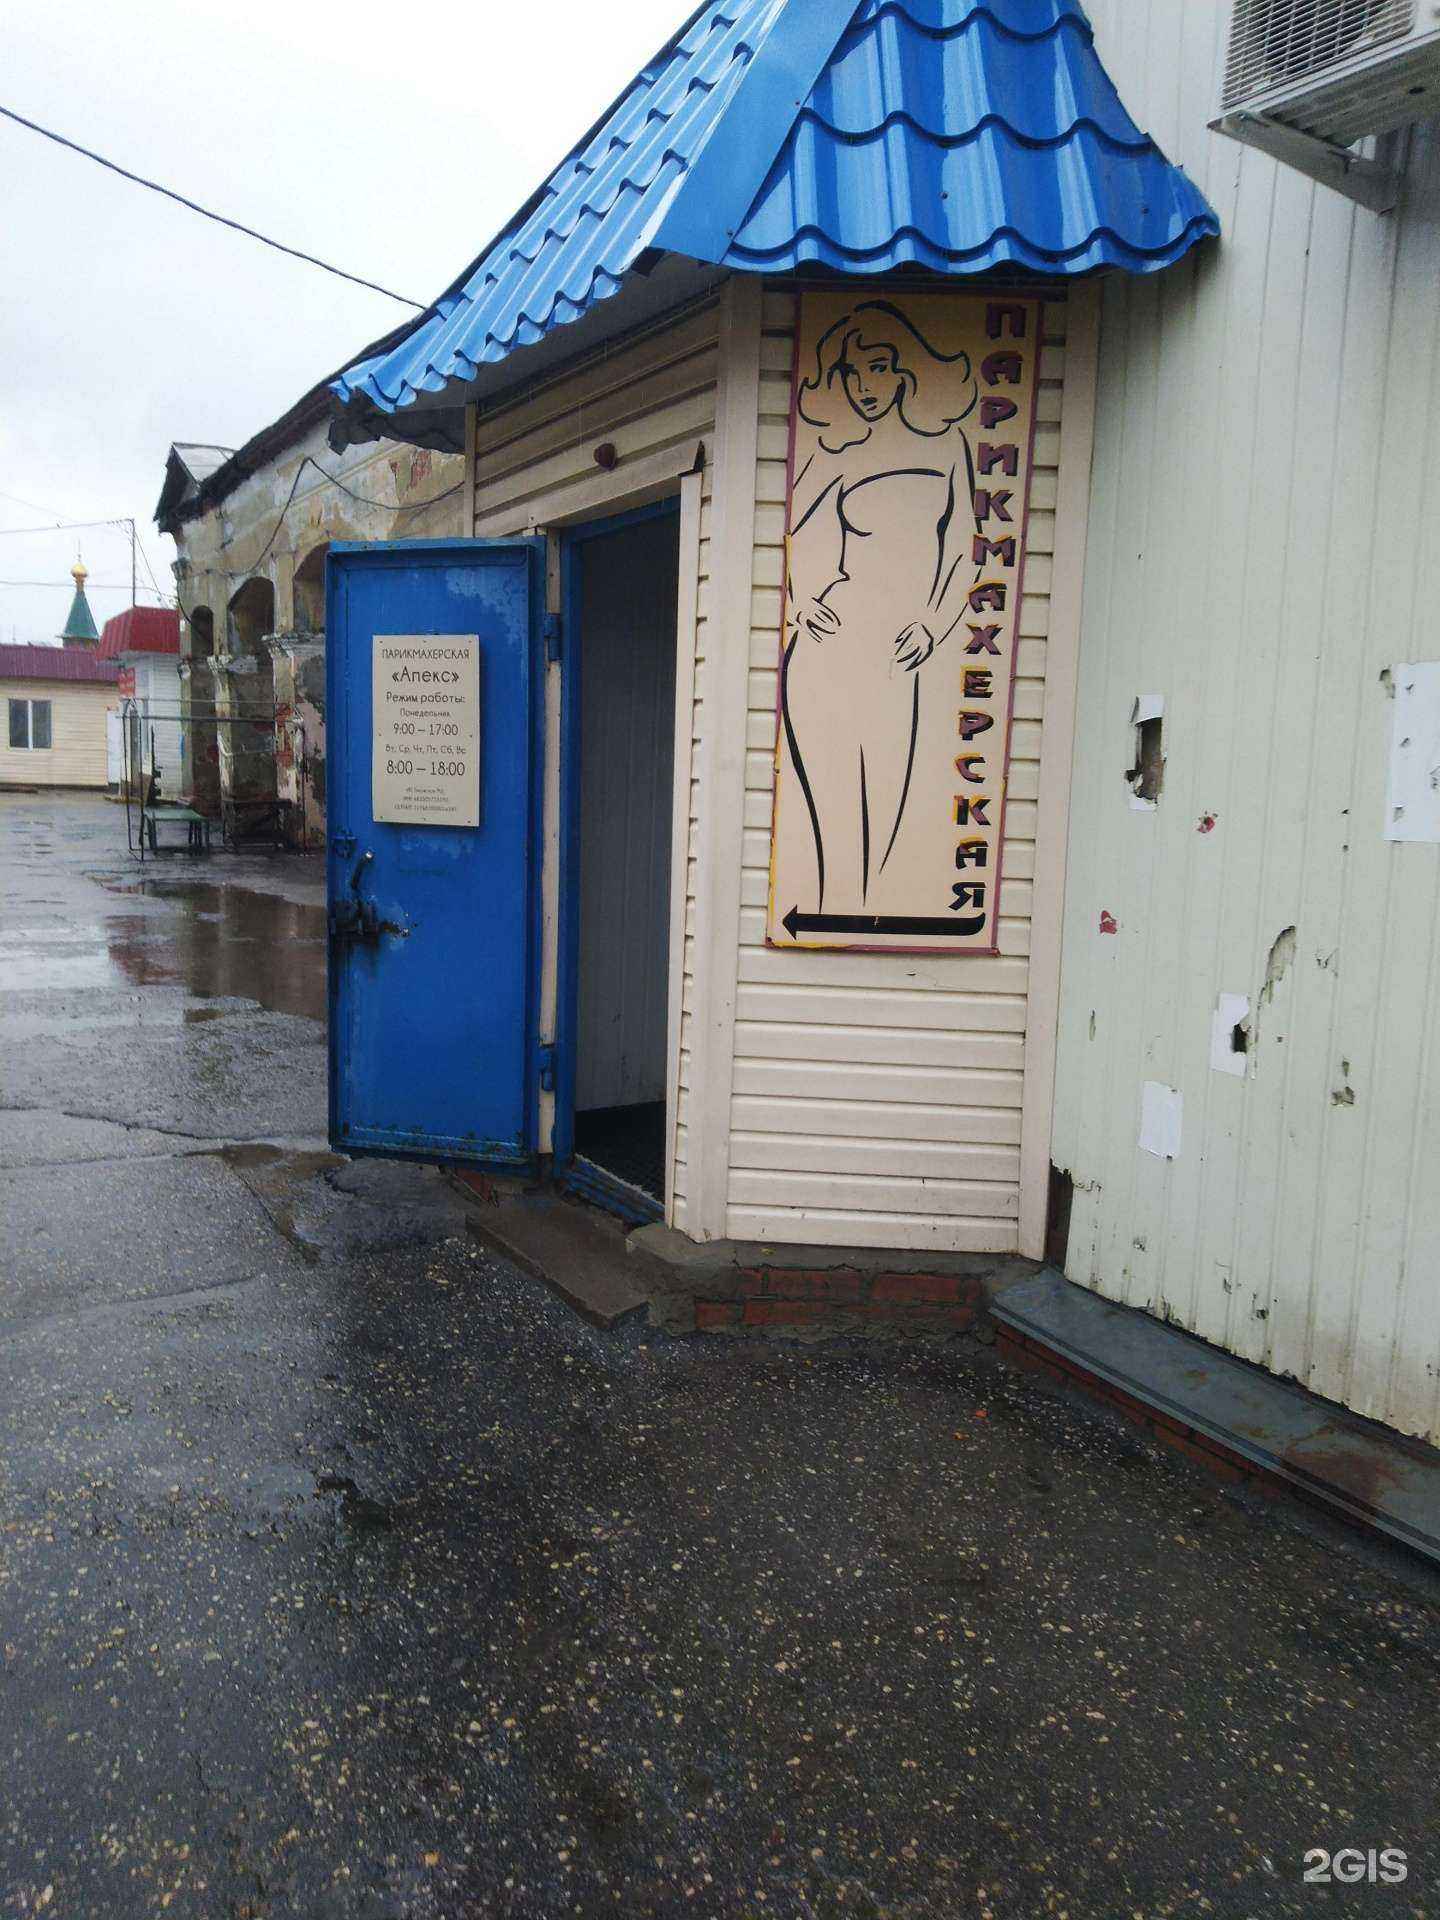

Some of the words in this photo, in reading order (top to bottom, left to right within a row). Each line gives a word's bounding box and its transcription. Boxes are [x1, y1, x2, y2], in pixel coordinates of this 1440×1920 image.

[948, 302, 1027, 911] ПАРИКМАХЕРСКАЯ
[382, 648, 470, 659] ПАРИКМАХЕРСКАЯ
[391, 665, 460, 683] «Апекс»
[386, 691, 418, 702] Режим
[420, 692, 466, 704] работы:
[400, 707, 451, 718] Понедельник
[393, 722, 415, 735] 9:00
[429, 723, 459, 736] 17:00
[386, 759, 413, 774] 8:00
[430, 761, 466, 776] 18:00
